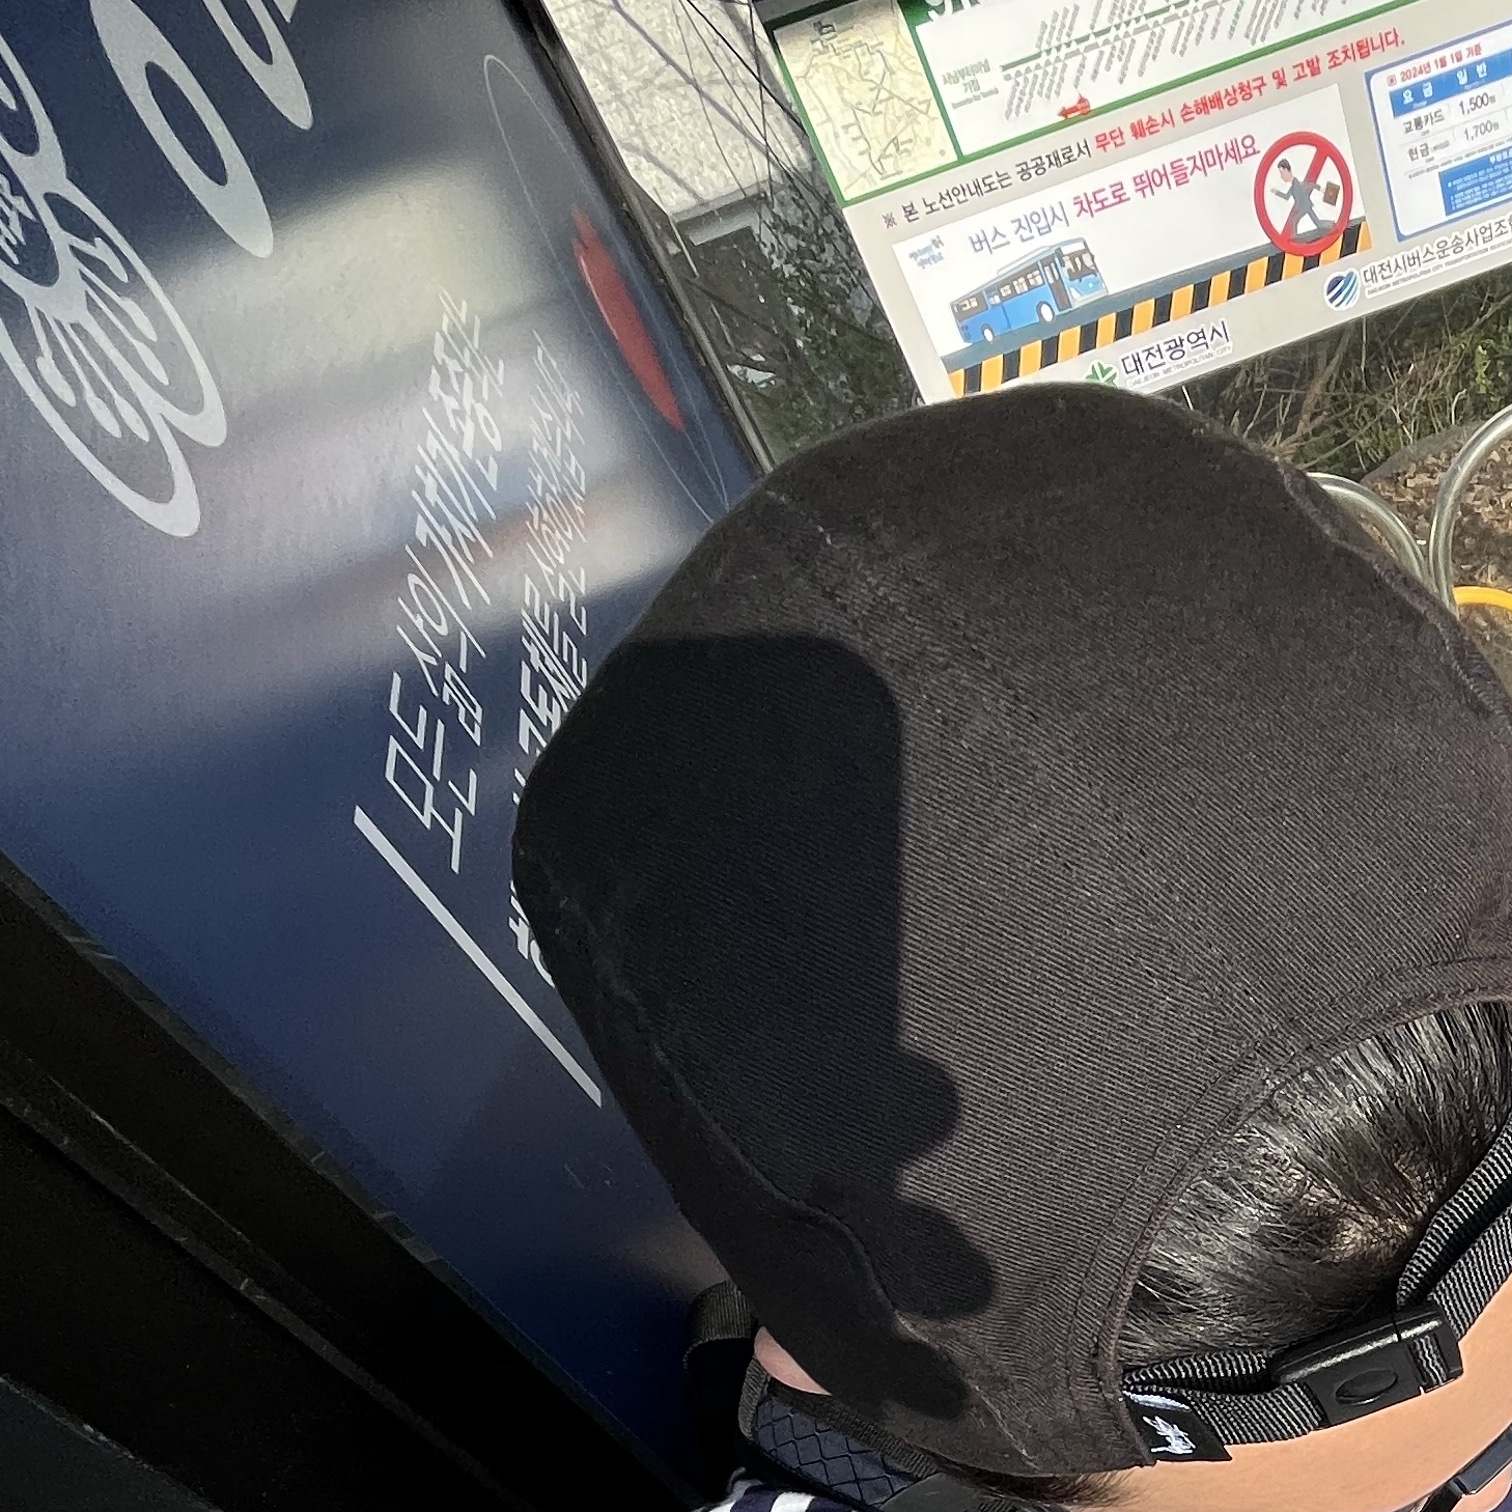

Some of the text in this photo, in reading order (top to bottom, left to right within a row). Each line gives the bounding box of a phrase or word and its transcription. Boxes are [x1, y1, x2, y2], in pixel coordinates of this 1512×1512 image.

[1400, 61, 1432, 82] 2024년
[901, 27, 1406, 223] 본 노선안내도는 공공재로서 무단 훼손시 손해배상청구 및 고발 조치됩니다.
[1403, 109, 1445, 134] 교통카드
[968, 226, 1011, 255] 버스
[1010, 200, 1070, 242] 진입시
[1072, 181, 1131, 218] 차도로
[1132, 134, 1261, 199] 뛰어들지마세요
[1121, 320, 1230, 375] 대전광역시
[385, 286, 504, 874] 모든 삶의 가치가 존중되는
